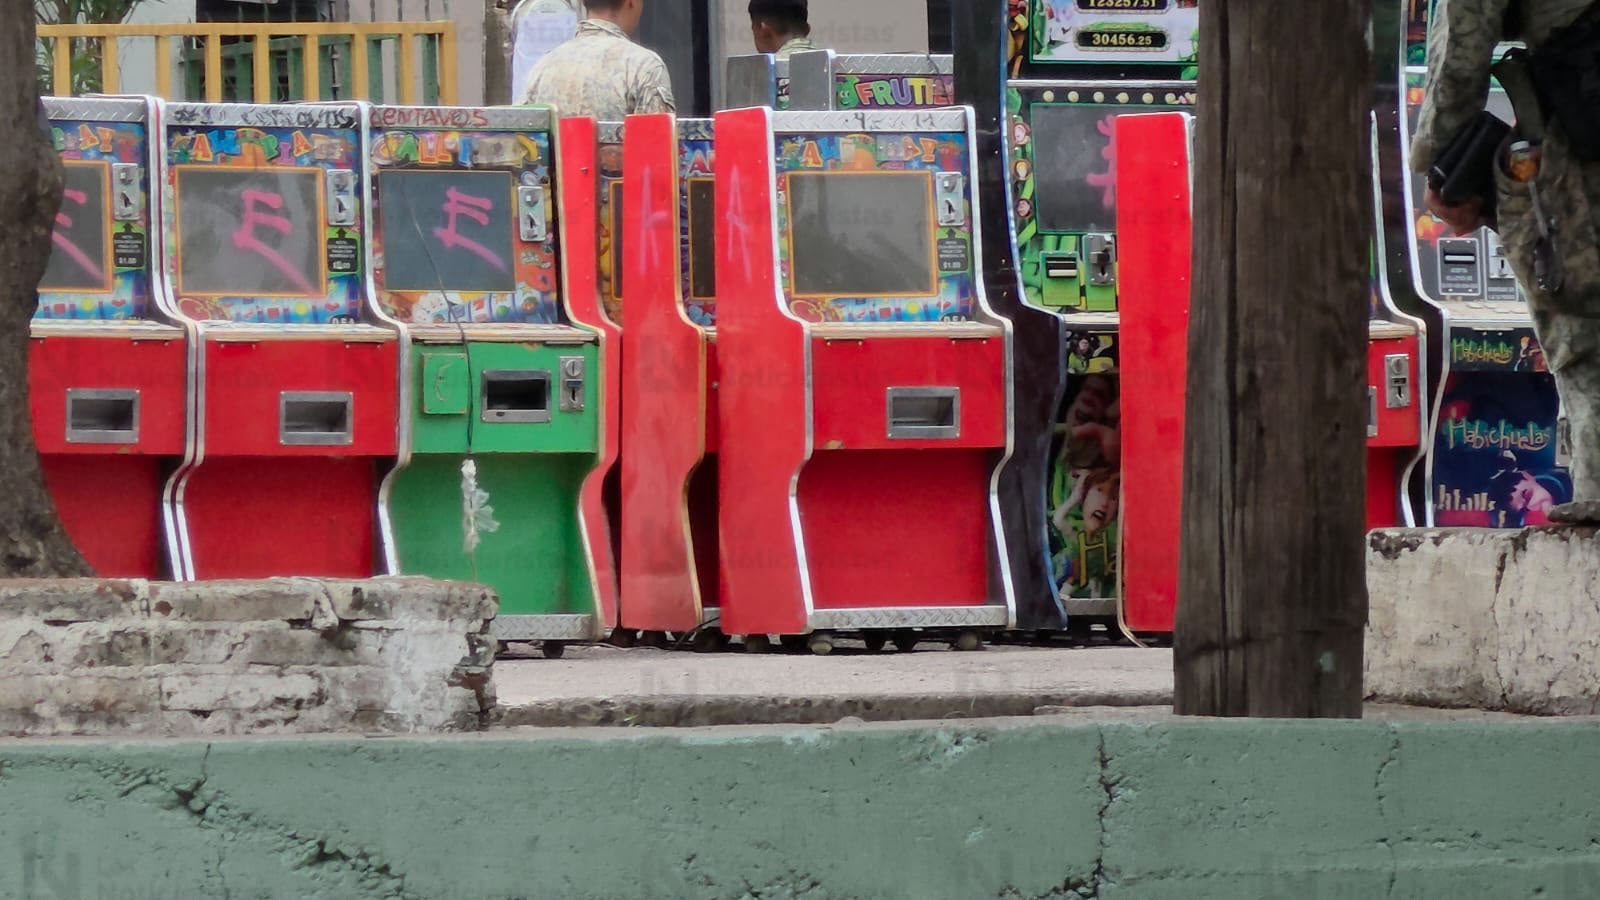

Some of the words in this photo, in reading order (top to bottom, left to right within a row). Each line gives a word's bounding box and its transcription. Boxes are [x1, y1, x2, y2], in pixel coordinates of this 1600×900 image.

[1092, 33, 1152, 46] 30456.25
[1451, 337, 1513, 365] Habichuelas
[1448, 417, 1550, 450] Habichuelas
